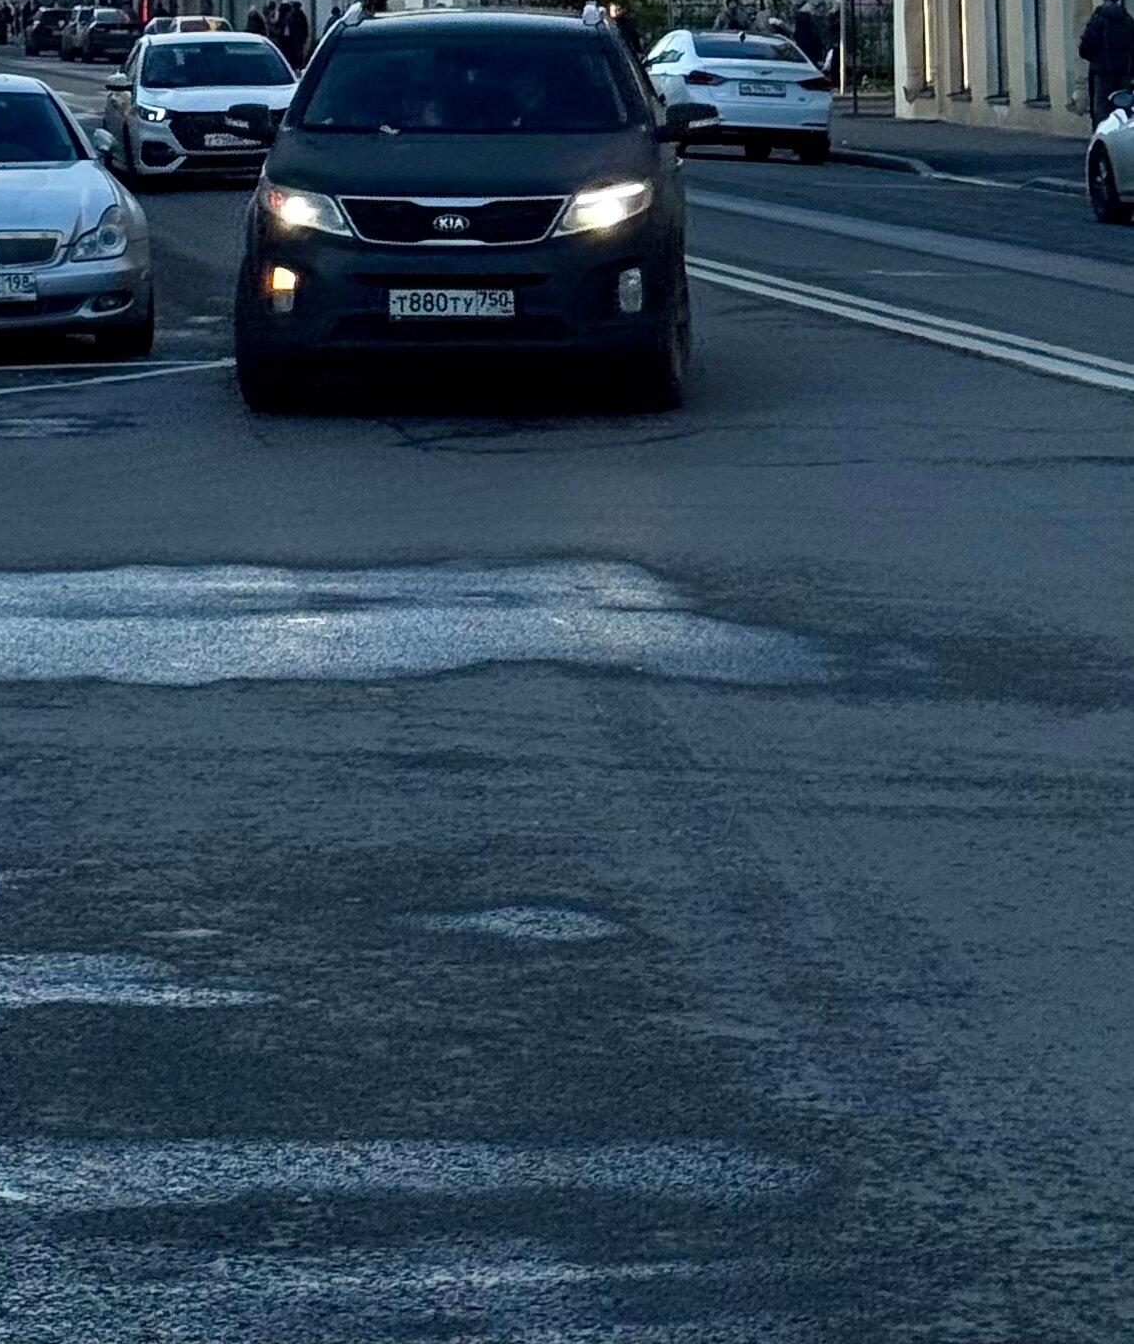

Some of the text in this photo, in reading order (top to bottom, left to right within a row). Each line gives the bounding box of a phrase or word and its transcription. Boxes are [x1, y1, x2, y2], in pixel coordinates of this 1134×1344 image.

[438, 217, 465, 229] KIA
[396, 291, 508, 314] Т880ТУ 750
